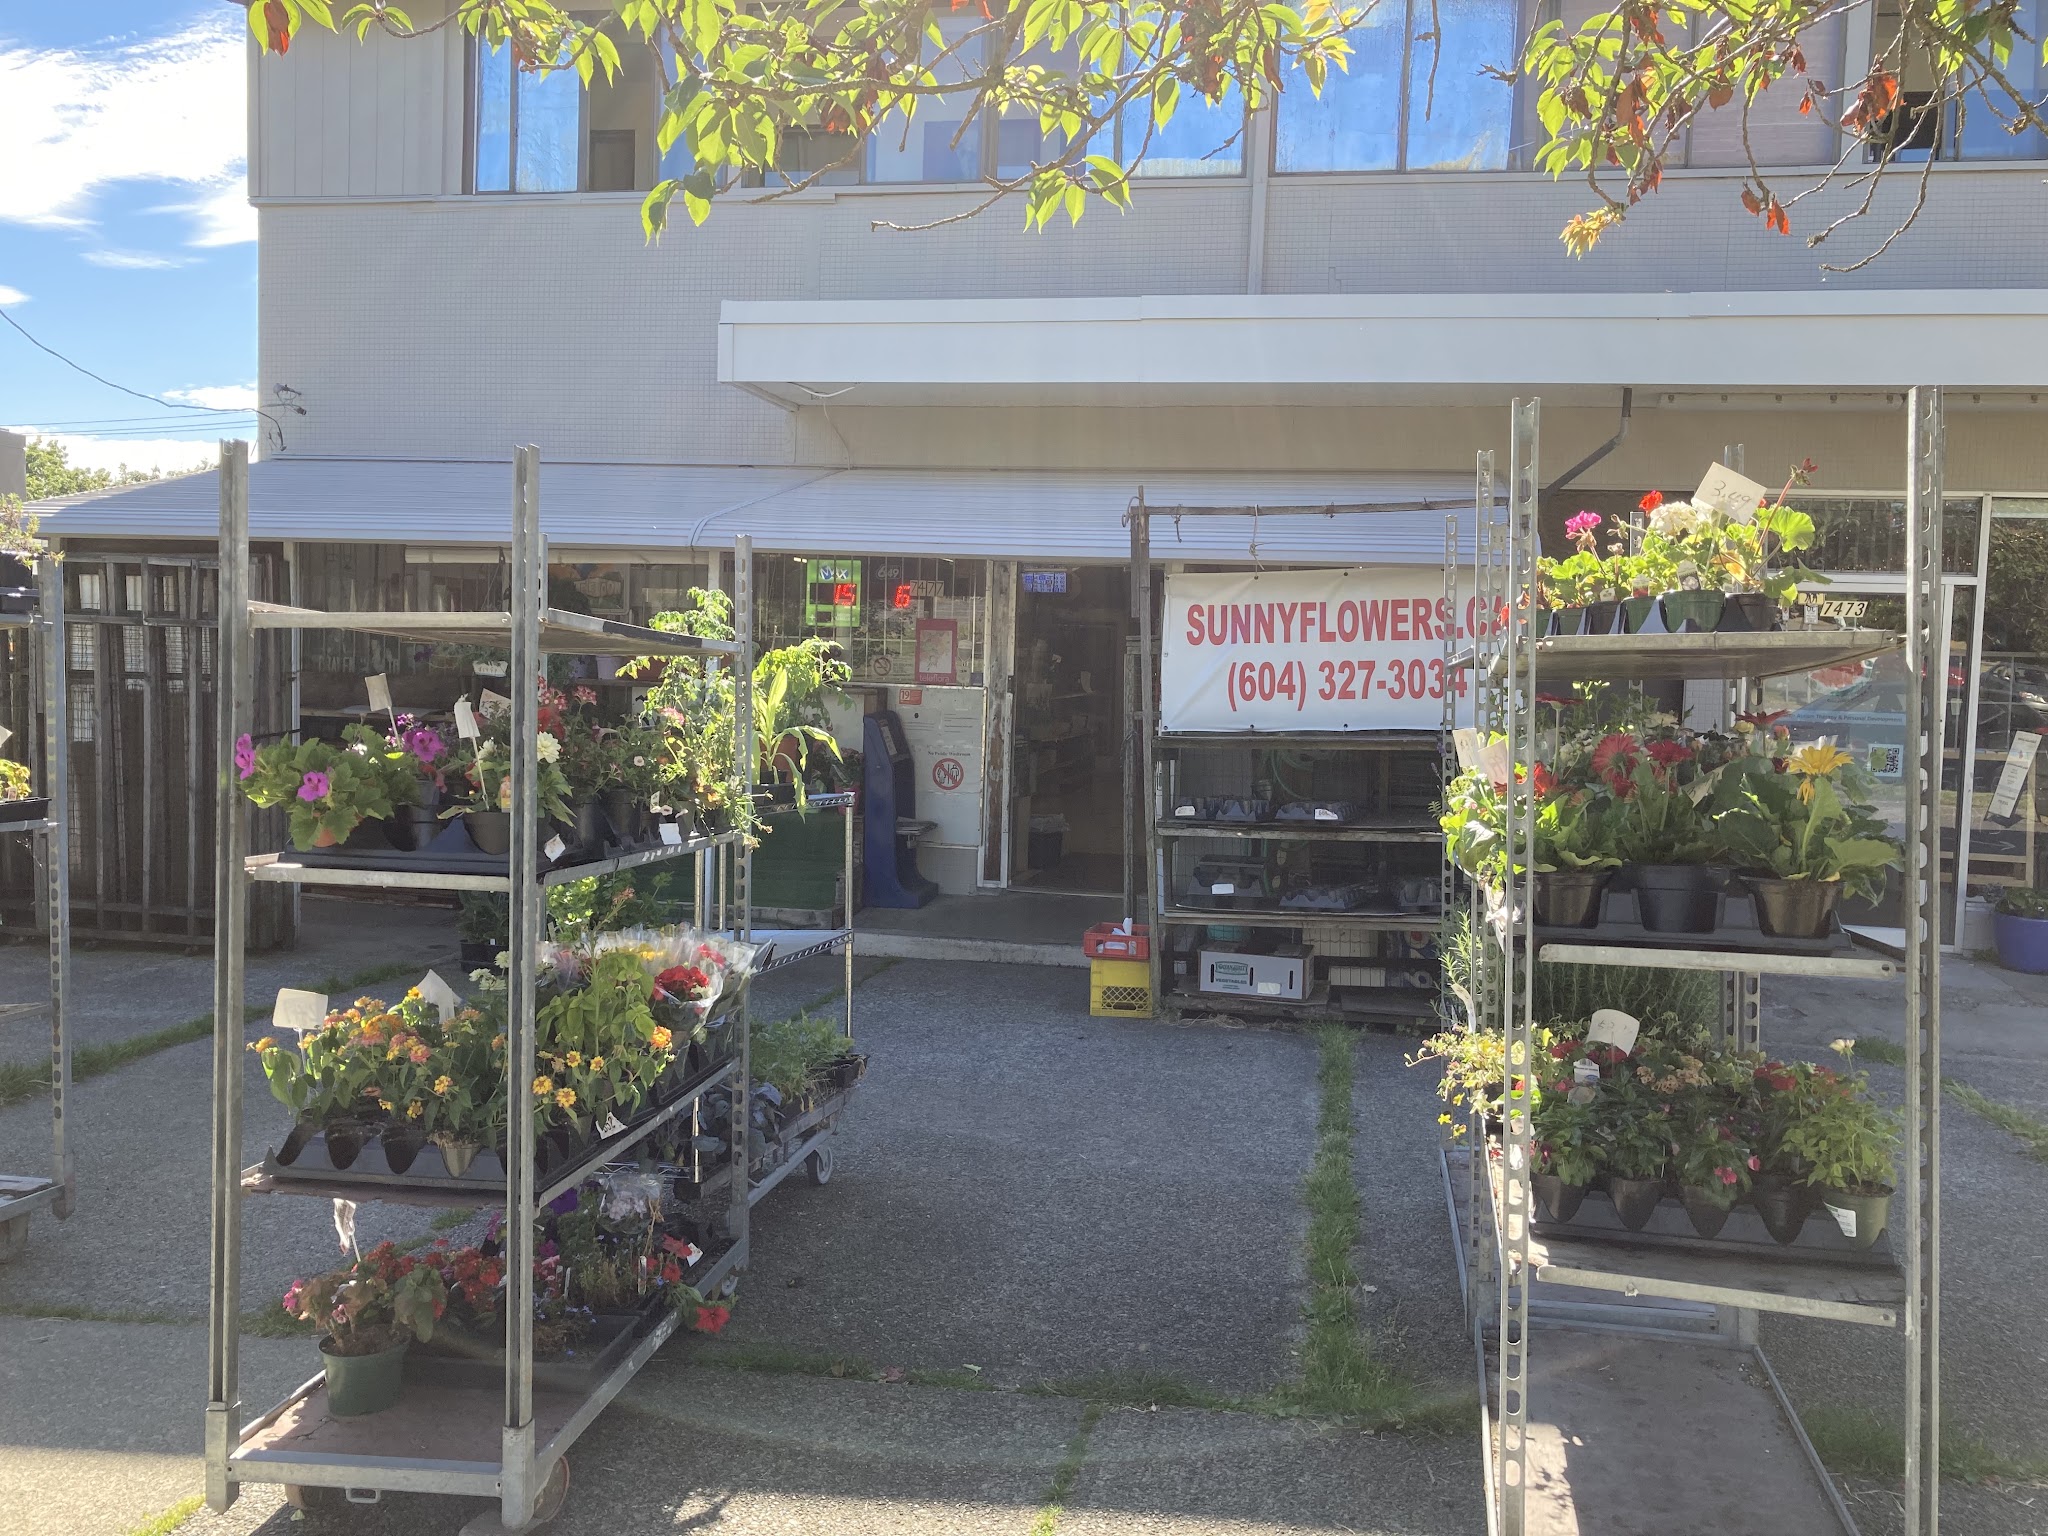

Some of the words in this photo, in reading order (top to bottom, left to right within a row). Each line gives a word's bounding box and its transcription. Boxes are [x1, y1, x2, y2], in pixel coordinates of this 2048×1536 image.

[1711, 480, 1752, 510] 3.49
[911, 581, 944, 596] 7477
[1823, 601, 1865, 617] 7473
[919, 673, 950, 683] teleflora
[1228, 661, 1307, 712] (604)
[1318, 659, 1468, 702] 327-3034
